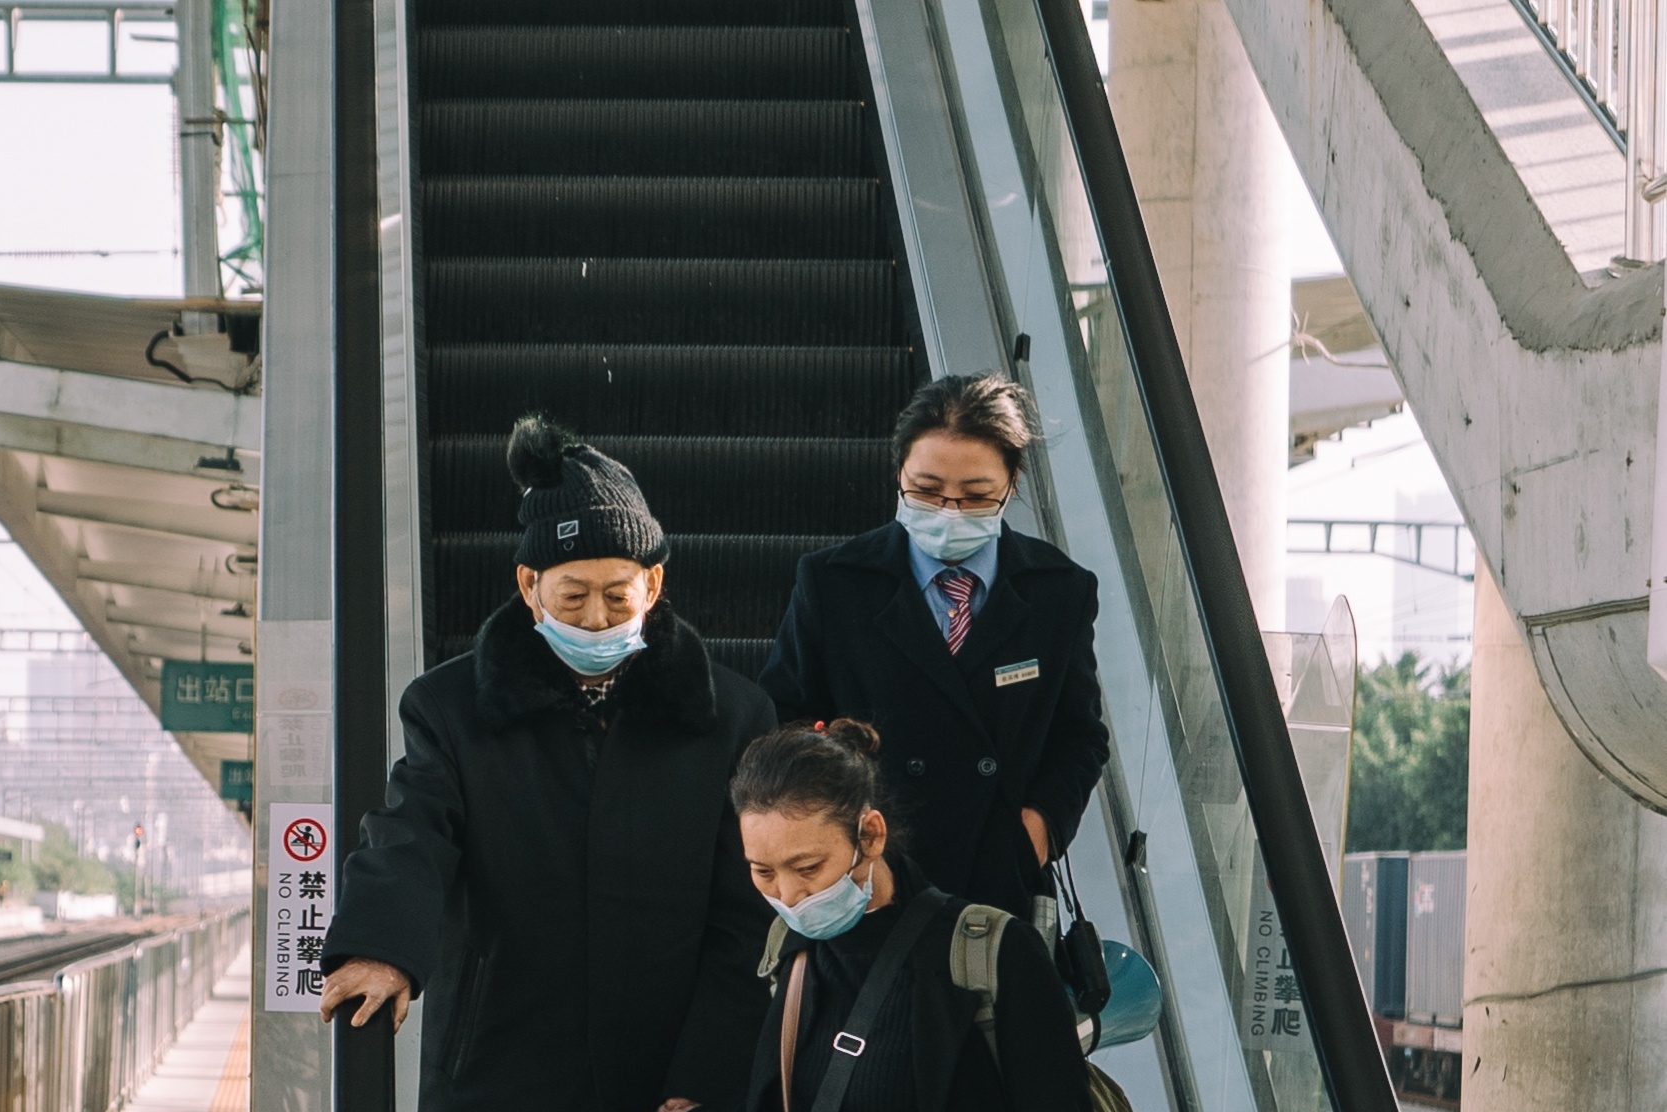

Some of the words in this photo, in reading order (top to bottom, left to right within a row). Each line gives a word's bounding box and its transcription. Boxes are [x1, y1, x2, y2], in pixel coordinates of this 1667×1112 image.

[176, 674, 253, 703] 出站口
[278, 872, 292, 899] NO
[1258, 910, 1273, 937] NO
[276, 908, 291, 997] CLIMBING
[295, 870, 327, 996] 禁止攀爬
[1251, 946, 1271, 1036] CLIMBING
[1271, 926, 1302, 1036] 攀爬
